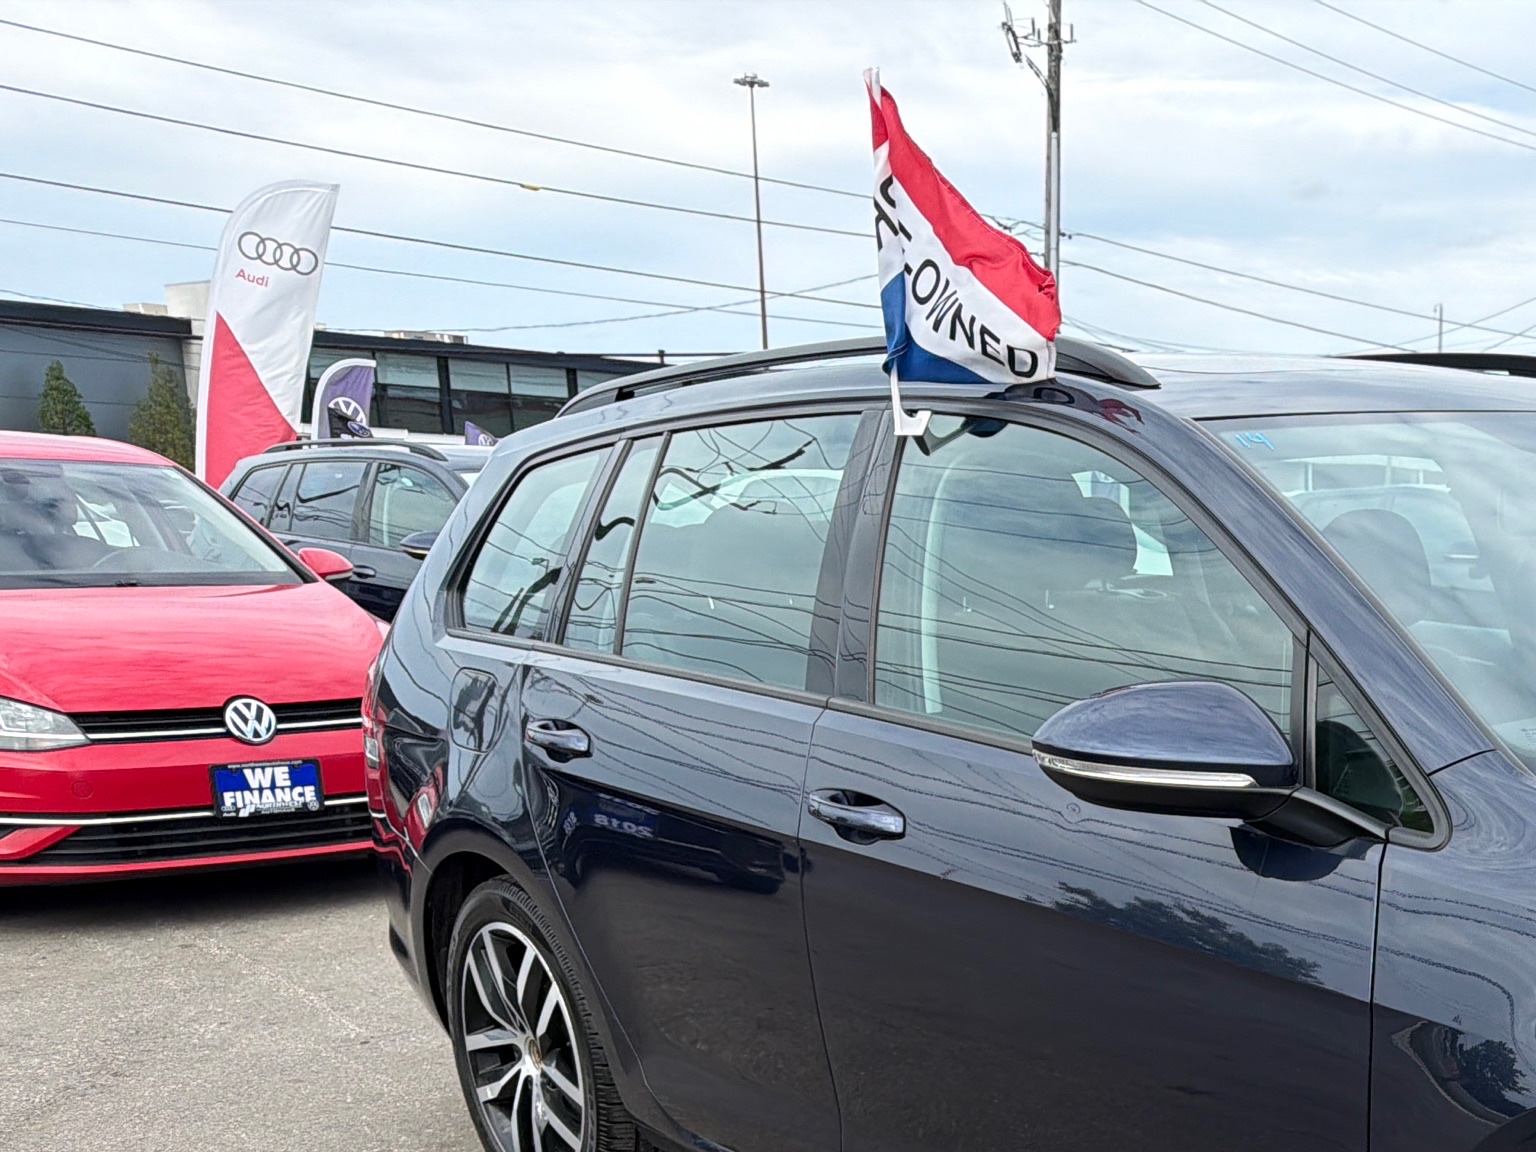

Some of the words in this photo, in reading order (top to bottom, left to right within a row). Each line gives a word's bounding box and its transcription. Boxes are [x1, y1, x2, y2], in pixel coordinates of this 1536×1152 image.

[235, 268, 269, 288] Audi
[1235, 431, 1275, 450] 14
[242, 766, 292, 789] WE
[222, 785, 317, 809] FINANCE
